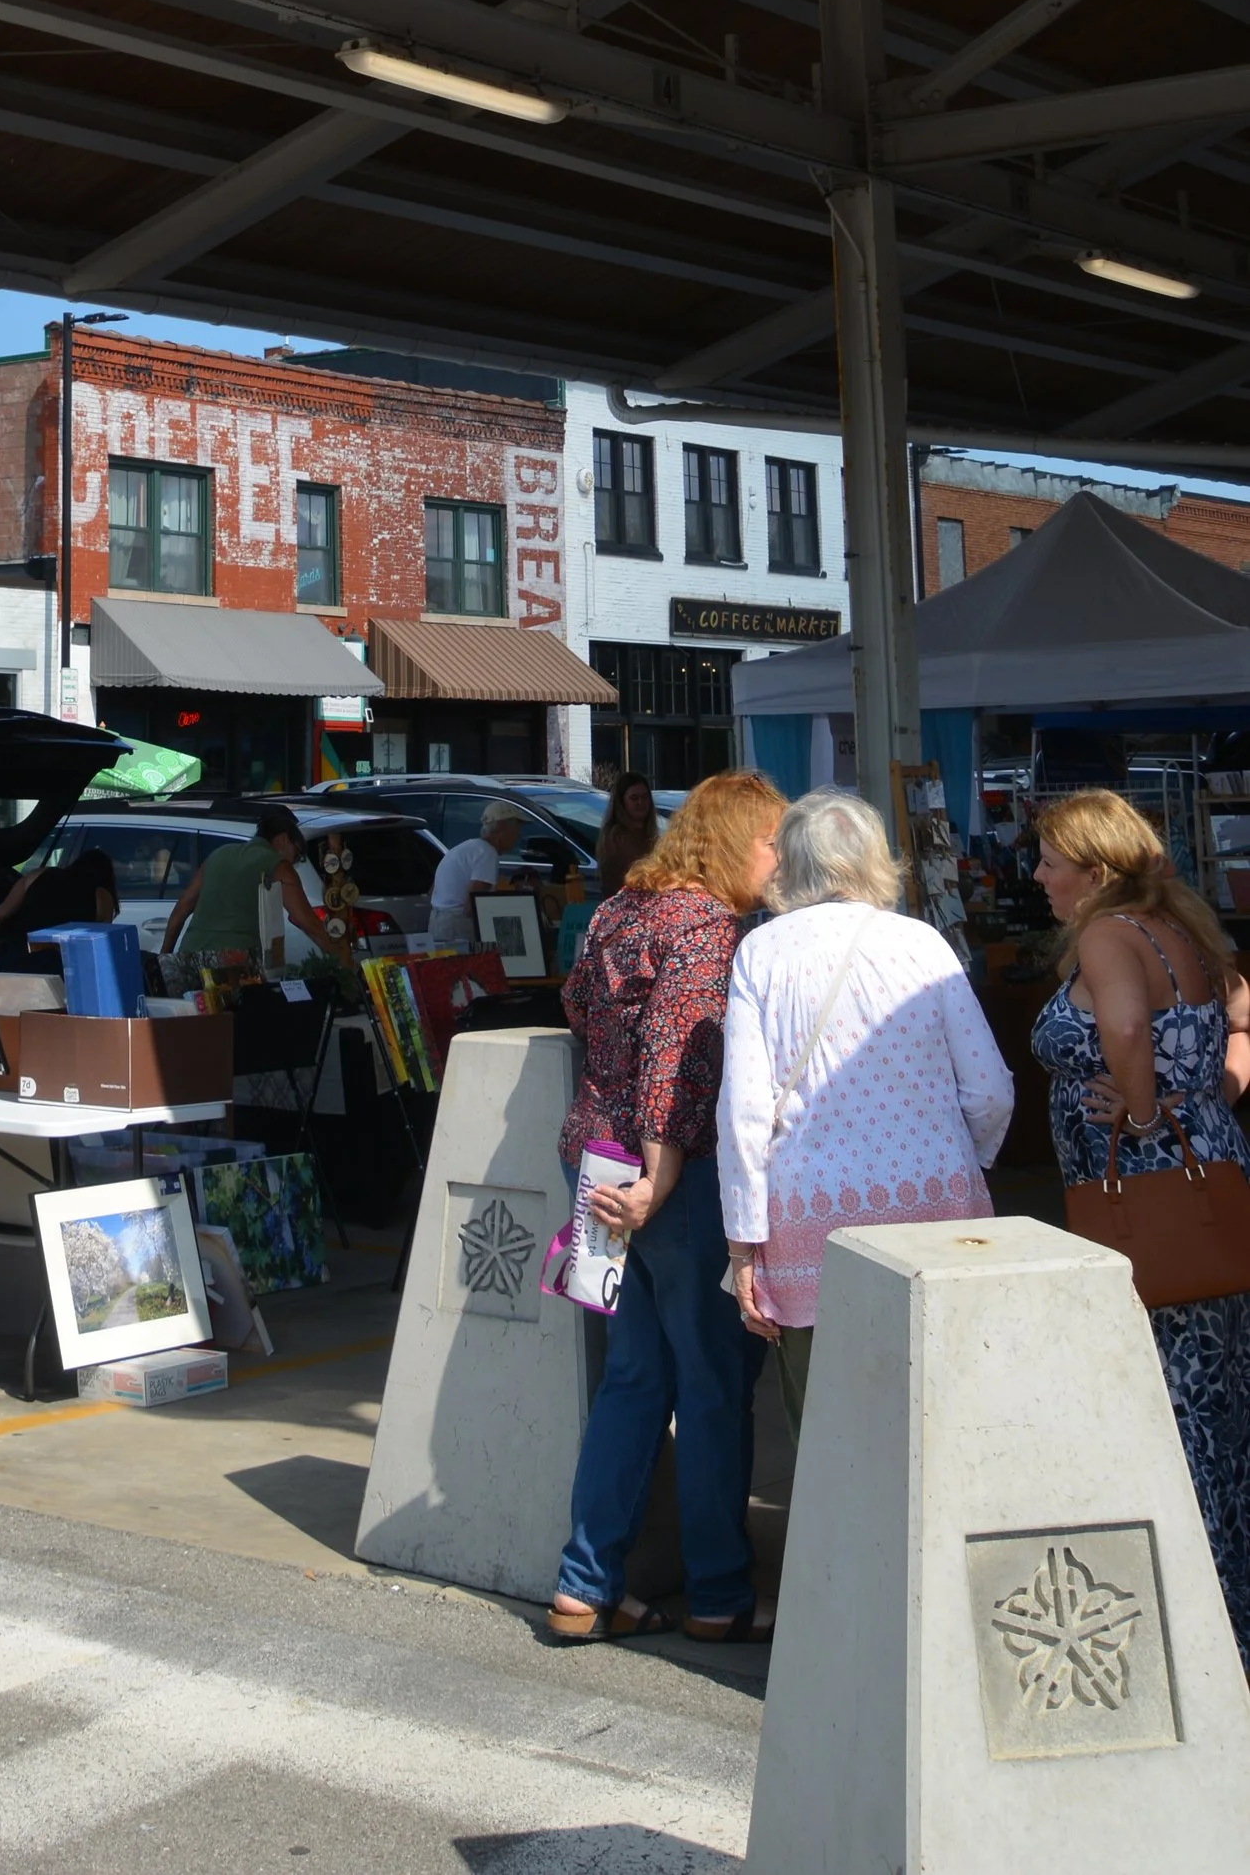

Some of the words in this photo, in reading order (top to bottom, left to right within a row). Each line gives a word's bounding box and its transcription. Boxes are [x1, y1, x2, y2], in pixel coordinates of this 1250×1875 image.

[700, 610, 761, 631] COFFEE
[776, 616, 838, 636] MARKET
[569, 1173, 597, 1274] delicious
[150, 1376, 174, 1388] PLASTIC
[150, 1387, 166, 1398] BAGS
